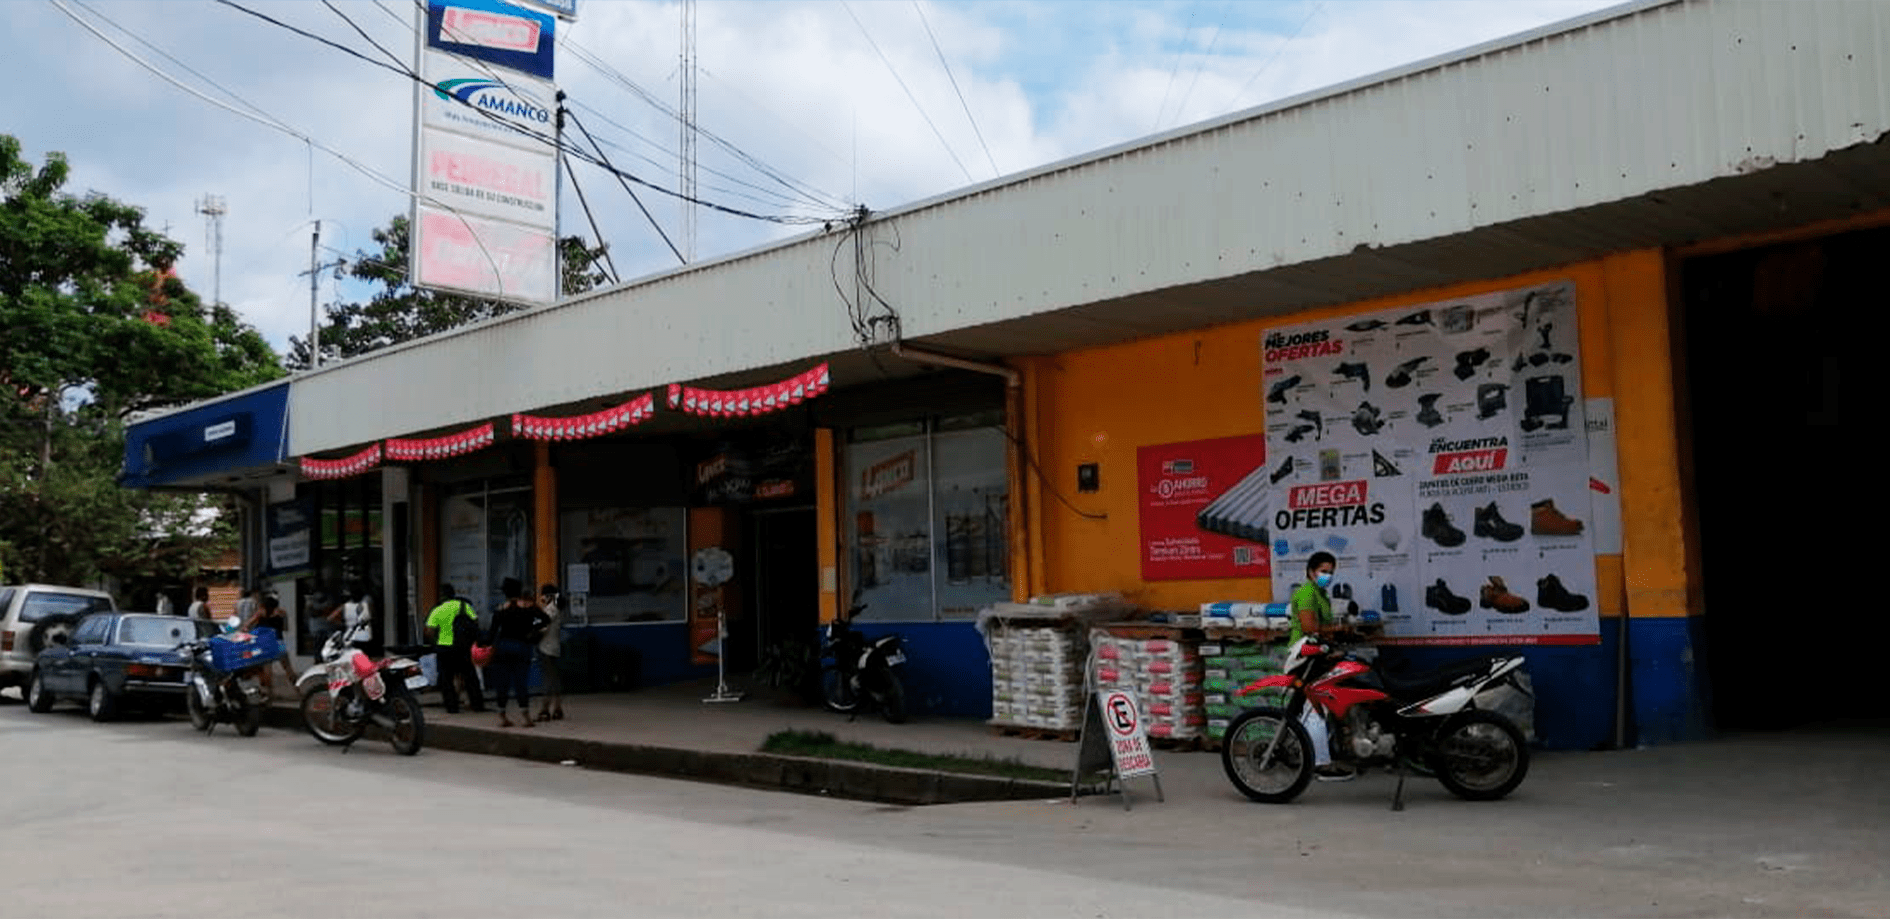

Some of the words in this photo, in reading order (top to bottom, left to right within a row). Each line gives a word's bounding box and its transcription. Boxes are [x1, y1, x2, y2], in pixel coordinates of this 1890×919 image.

[478, 93, 548, 123] AMANCO
[430, 150, 547, 200] PEDREGAL
[431, 181, 448, 192] BASE
[486, 191, 496, 202] SU
[1265, 330, 1329, 350] MEJORES
[1265, 340, 1343, 362] OFERTAS
[1429, 435, 1508, 453] ENCUENTRA
[1450, 478, 1459, 487] DE
[1460, 476, 1484, 486] CUERO
[1486, 474, 1508, 484] MEDIA
[1296, 484, 1361, 506] MEGA
[1275, 502, 1385, 530] OFERTAS
[1114, 701, 1131, 727] E
[1115, 739, 1133, 754] ZONA
[1133, 736, 1143, 752] DE
[1118, 753, 1151, 772] DESCARGA
